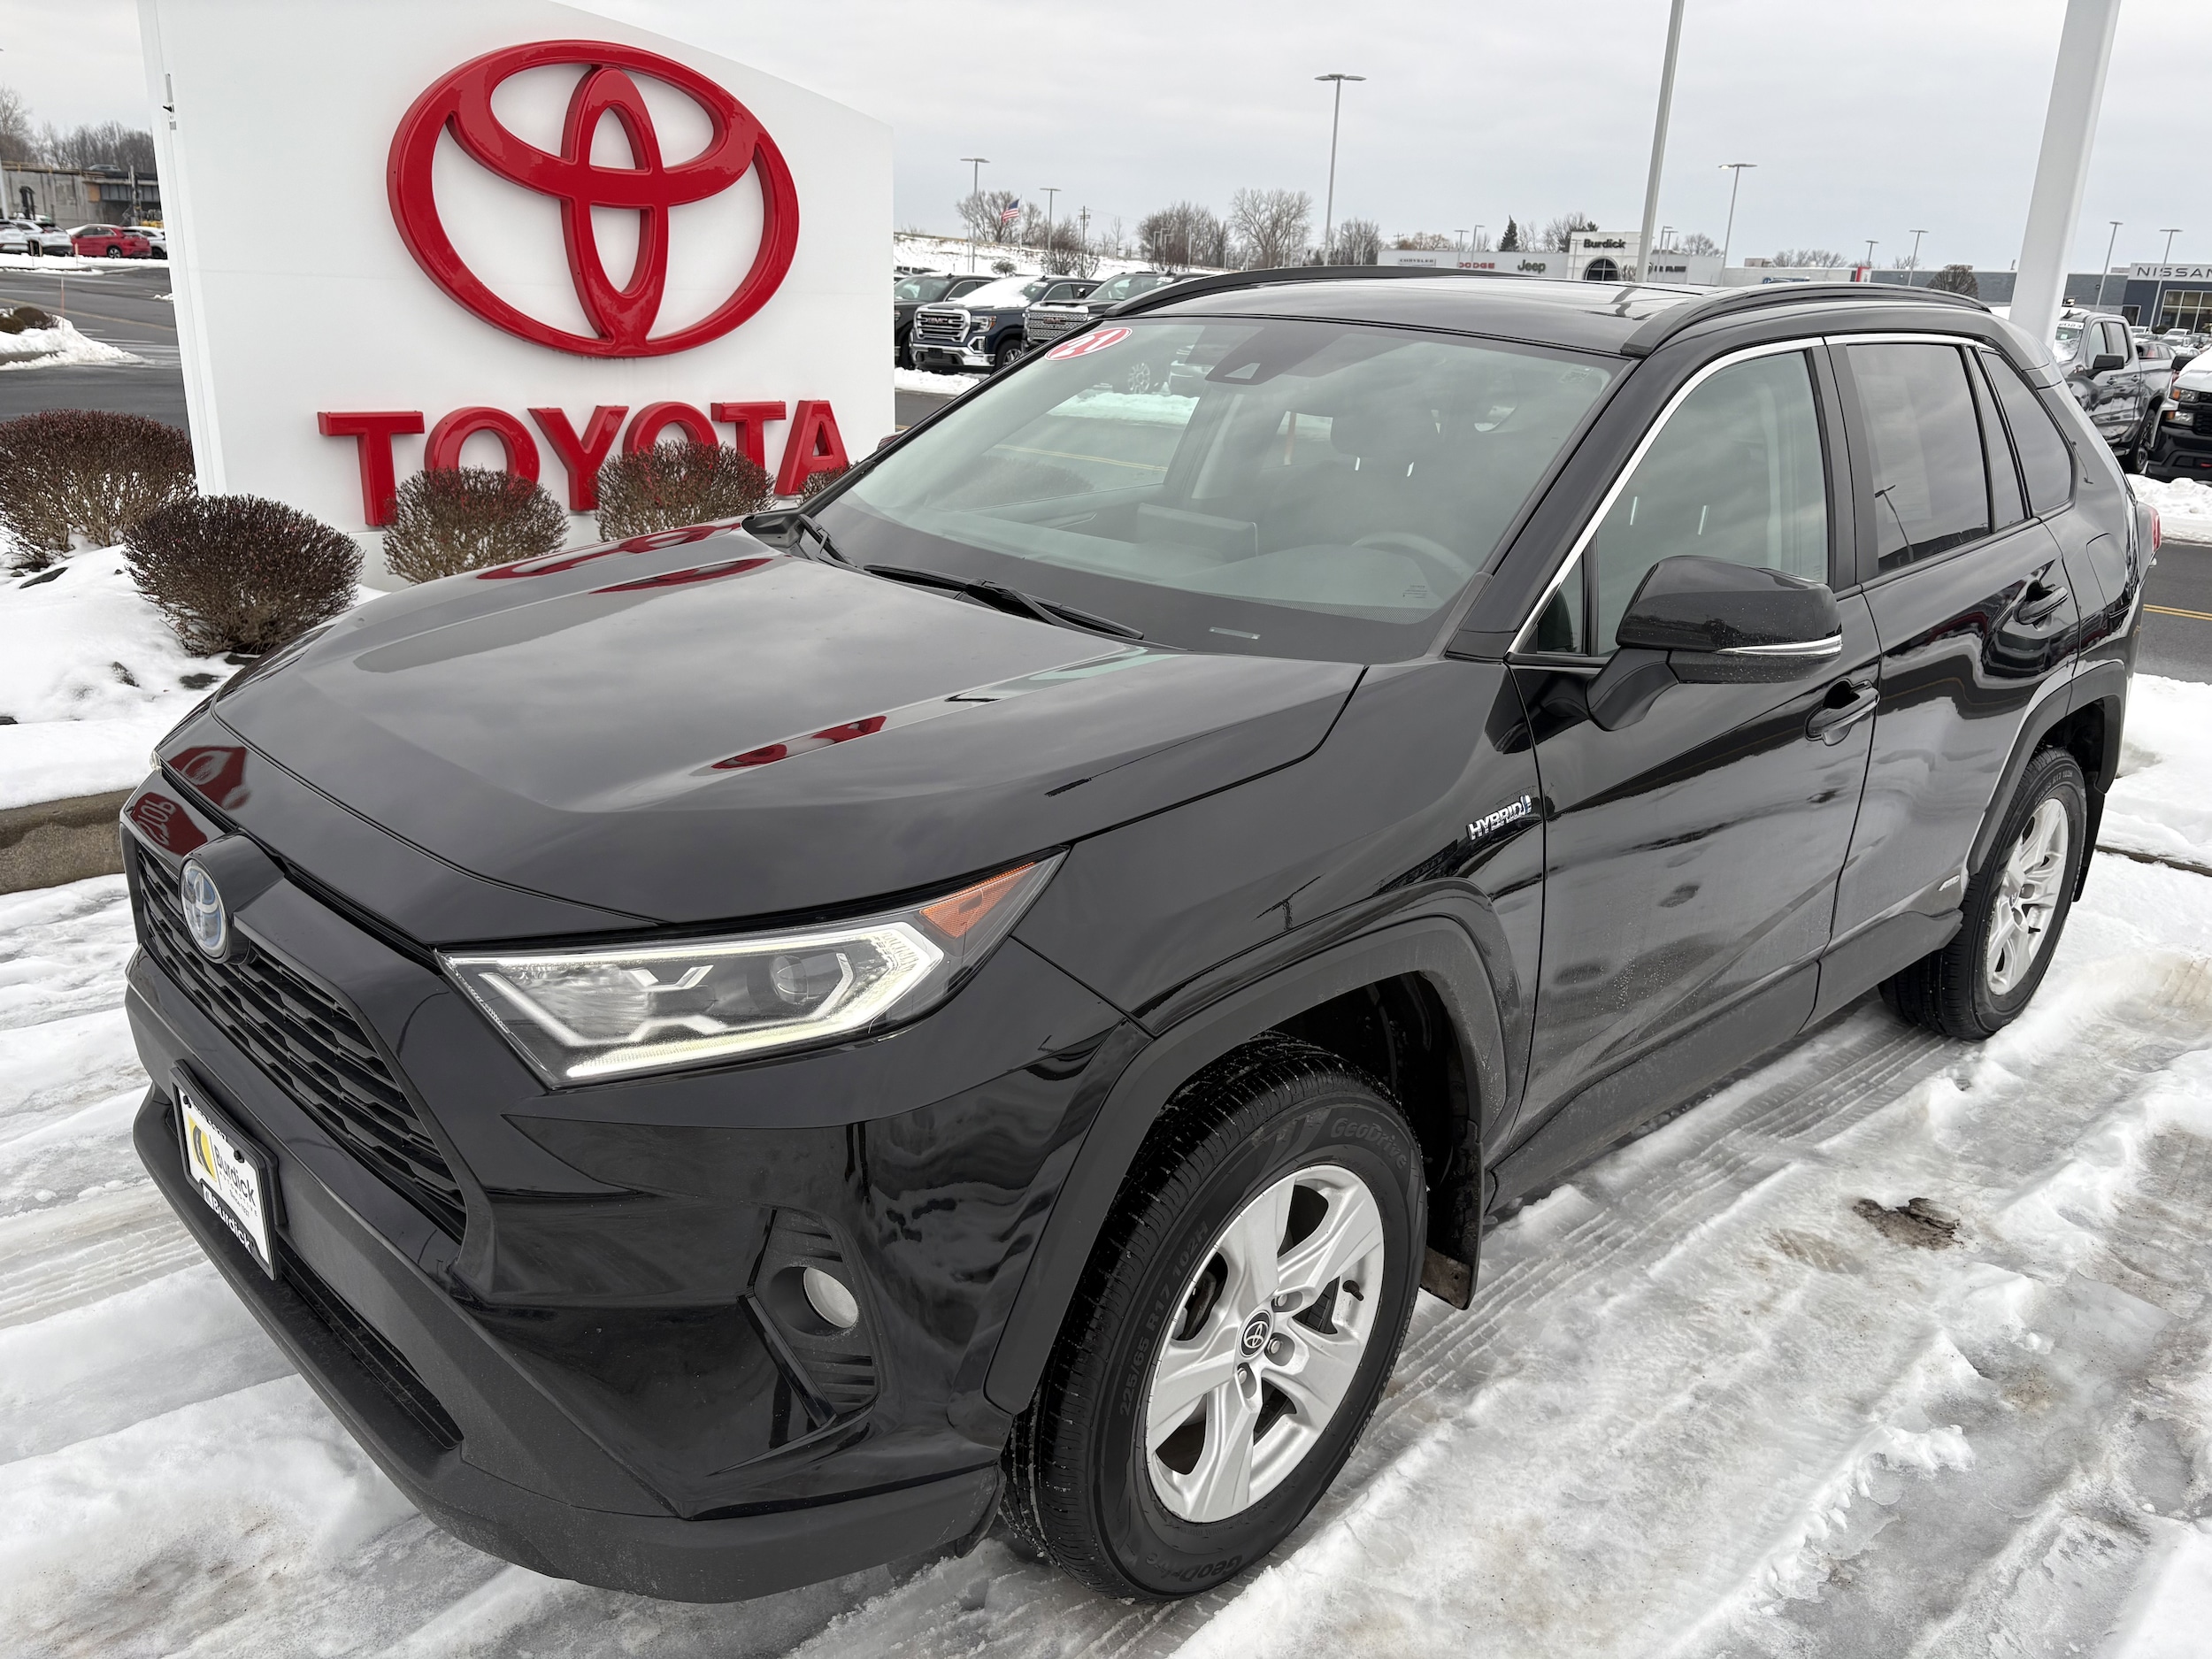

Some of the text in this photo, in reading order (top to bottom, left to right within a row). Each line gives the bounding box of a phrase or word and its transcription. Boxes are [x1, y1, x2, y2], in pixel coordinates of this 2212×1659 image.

[1584, 238, 1626, 249] Burdick
[1517, 259, 1547, 273] Jeep
[1048, 329, 1123, 359] 21
[1468, 801, 1526, 841] HYBRID
[213, 1144, 257, 1208] Burdick
[212, 1195, 253, 1254] Burdick
[1119, 1220, 1210, 1417] 225/65 R17 102H
